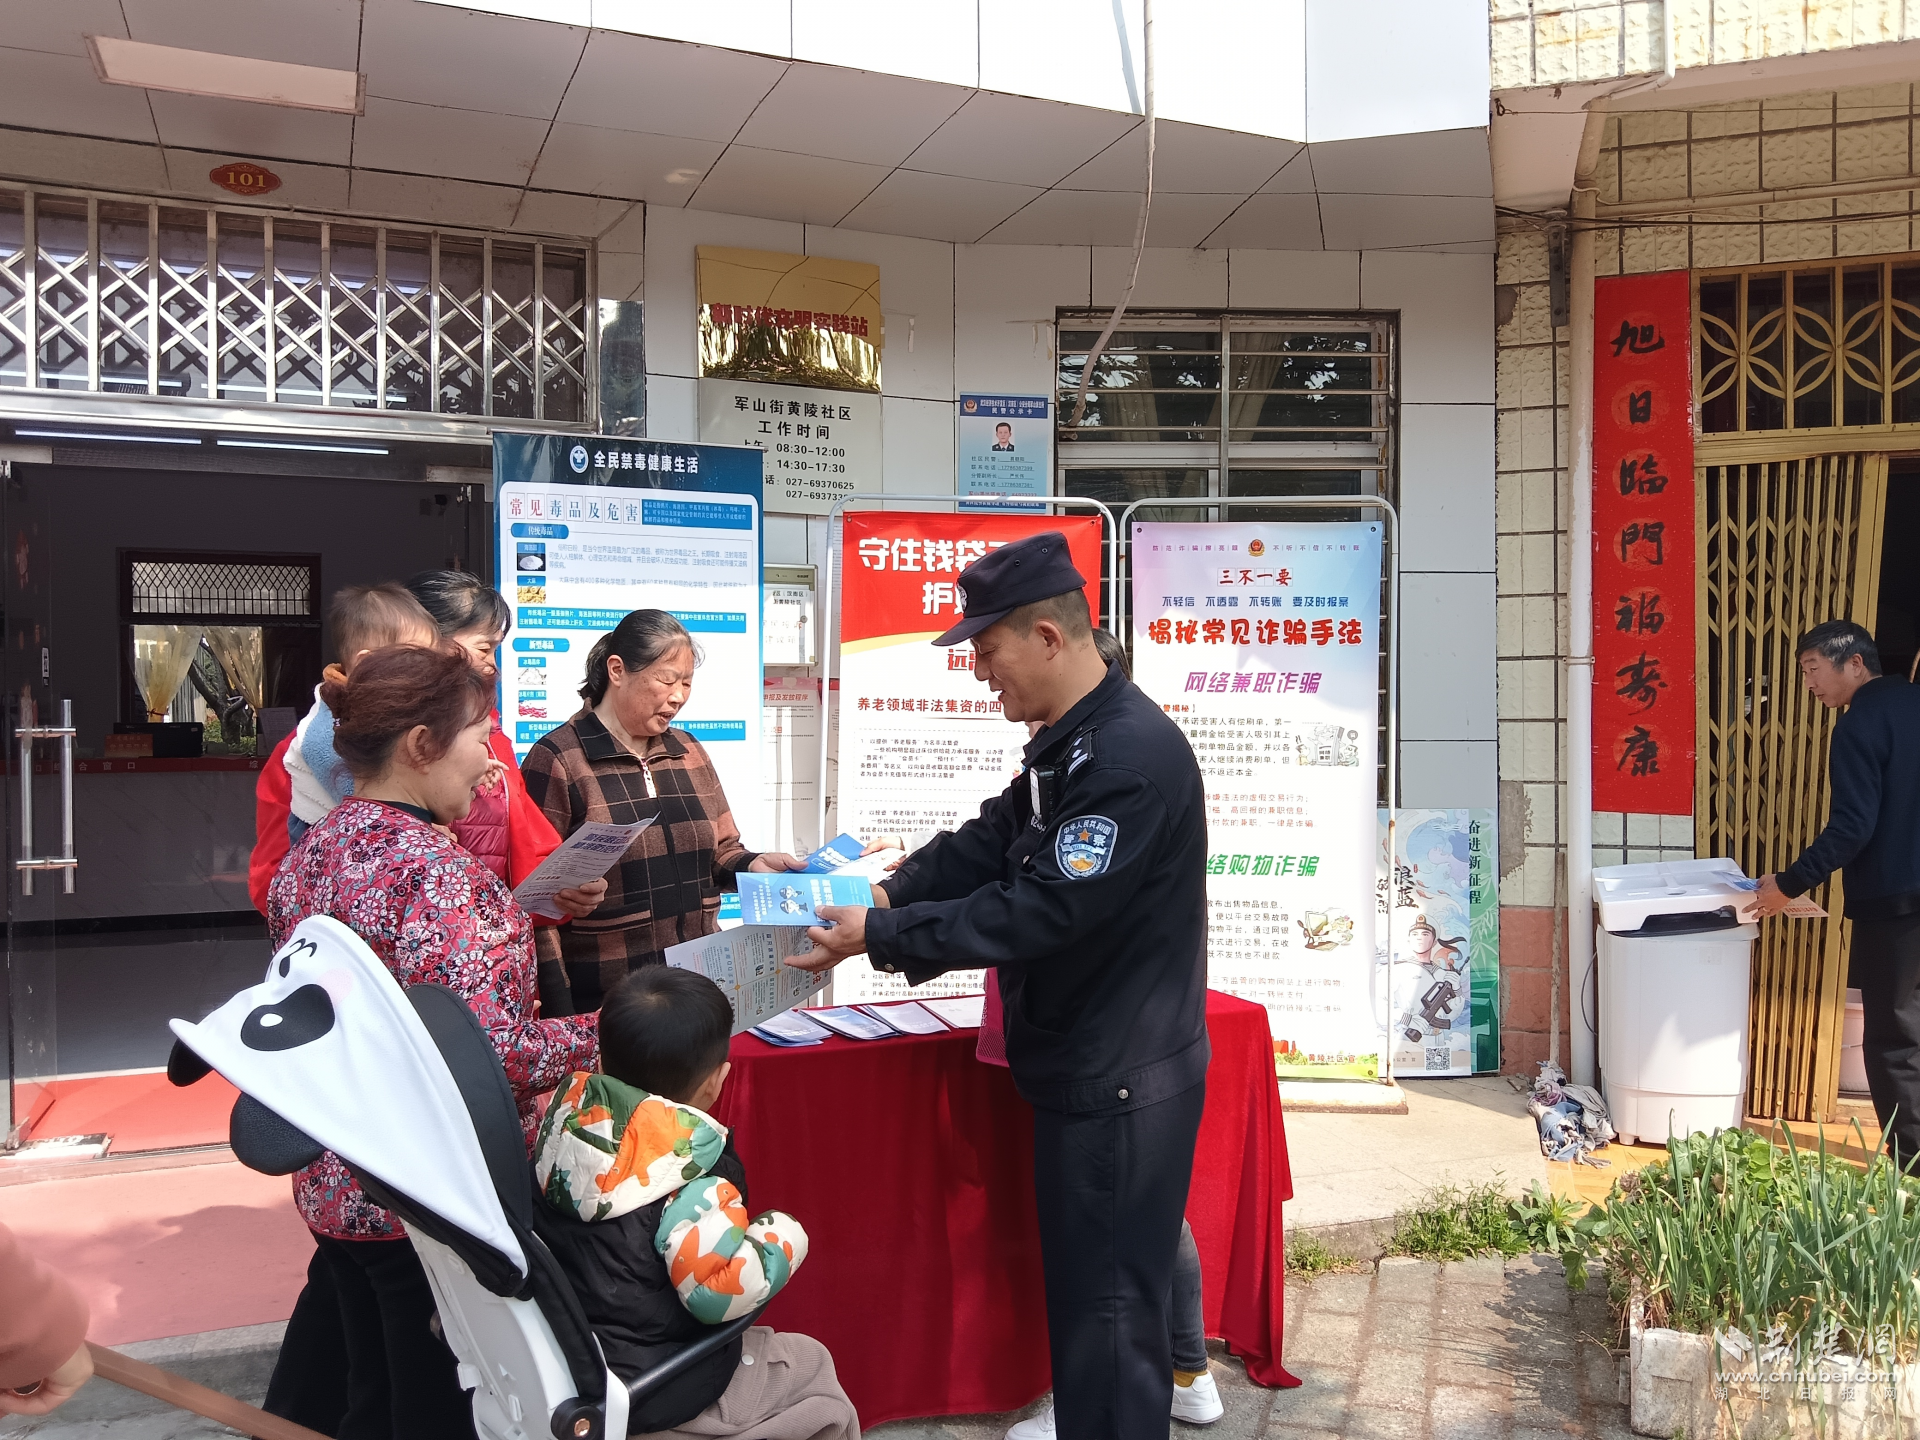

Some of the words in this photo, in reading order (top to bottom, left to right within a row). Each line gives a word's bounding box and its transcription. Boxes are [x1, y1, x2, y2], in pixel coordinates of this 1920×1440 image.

[227, 172, 266, 187] 101
[711, 302, 869, 337] 新时代文明实践站
[734, 396, 852, 420] 军山街黄陵社区
[758, 421, 830, 440] 工作时间
[776, 443, 845, 457] 08:30-12:00
[594, 451, 699, 474] 全民禁毒健康生活
[777, 459, 845, 473] 14:30-17:30
[786, 478, 855, 490] 027-69370625
[509, 497, 638, 522] 常见毒品及危害
[528, 526, 553, 536] 传统毒品
[858, 537, 1010, 573] 守住钱袋
[1219, 568, 1292, 587] 三不一要
[1162, 596, 1195, 607] 不轻信
[1205, 596, 1239, 607] 不透露
[1249, 596, 1282, 607] 不转账
[1293, 596, 1349, 607] 要及时报案
[1148, 618, 1363, 646] 揭秘常见诈骗手法
[1184, 671, 1323, 694] 网络兼职诈骗
[858, 697, 1002, 713] 养老领域非法集资的四
[1158, 703, 1196, 713] 警揭秘】
[1195, 755, 1290, 764] 害人继续消费刷单，但
[1063, 819, 1112, 836] 中华人民共和国
[1206, 854, 1320, 876] 络购物诈骗
[1468, 819, 1481, 905] 奋进新征程
